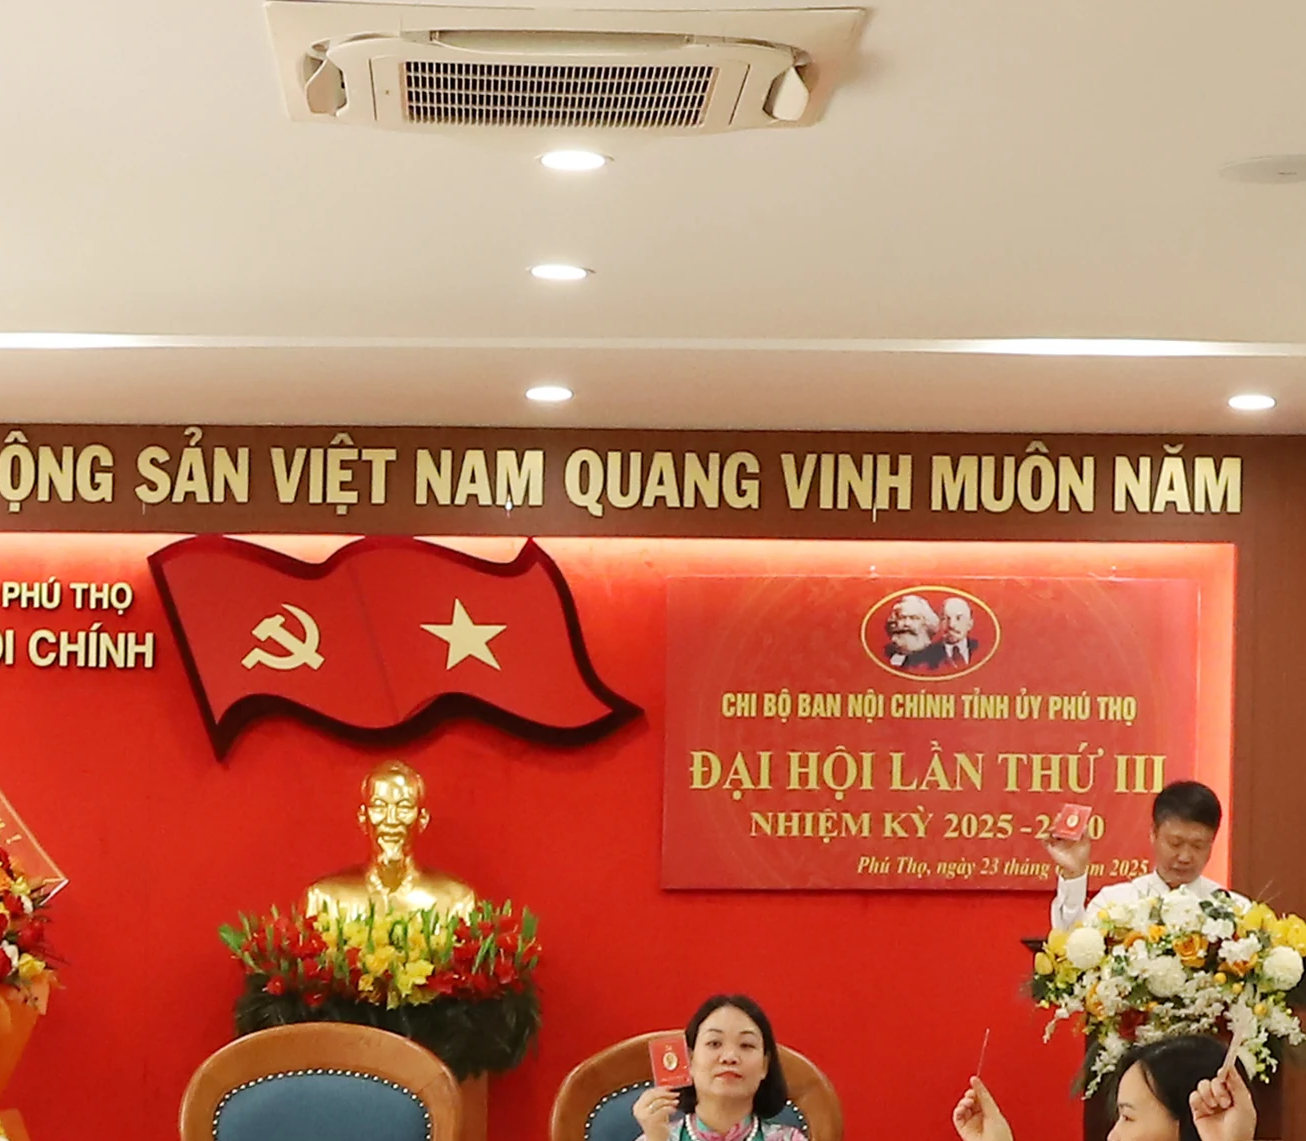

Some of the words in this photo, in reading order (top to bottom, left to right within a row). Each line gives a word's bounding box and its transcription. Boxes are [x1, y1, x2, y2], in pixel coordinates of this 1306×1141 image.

[135, 427, 249, 503] SẢN
[271, 432, 396, 515] VIỆT
[415, 449, 544, 506] NAM
[564, 449, 760, 516] QUANG
[781, 454, 912, 511] VINH
[931, 441, 1094, 512] MUÔN
[1113, 443, 1242, 513] NĂM
[2, 576, 60, 609] PHÚ
[69, 582, 133, 615] THỌ
[28, 622, 154, 668] CHÍNH
[722, 692, 757, 717] CHI
[763, 688, 792, 723] BỘ
[797, 693, 842, 718] BAN
[847, 688, 885, 723] NỘI
[890, 688, 956, 719] CHÍNH
[960, 687, 1010, 720] TỈNH
[1015, 687, 1043, 720] ỦY
[1048, 690, 1092, 721] PHÚ
[1096, 695, 1137, 726] THỌ
[689, 750, 773, 800] ĐẠI
[786, 745, 875, 801] HỘI
[889, 740, 985, 793] LẦN
[997, 742, 1105, 793] THỨ
[1114, 754, 1167, 794] III
[750, 808, 871, 844] NHIỆM
[883, 805, 934, 838] KỲ
[943, 813, 1013, 840] 2025
[857, 855, 891, 874] Phú
[896, 856, 932, 877] Thọ,
[936, 857, 976, 878] ngày
[980, 857, 1000, 875] 23
[1003, 857, 1051, 880] tháng
[1109, 859, 1150, 877] 2025
